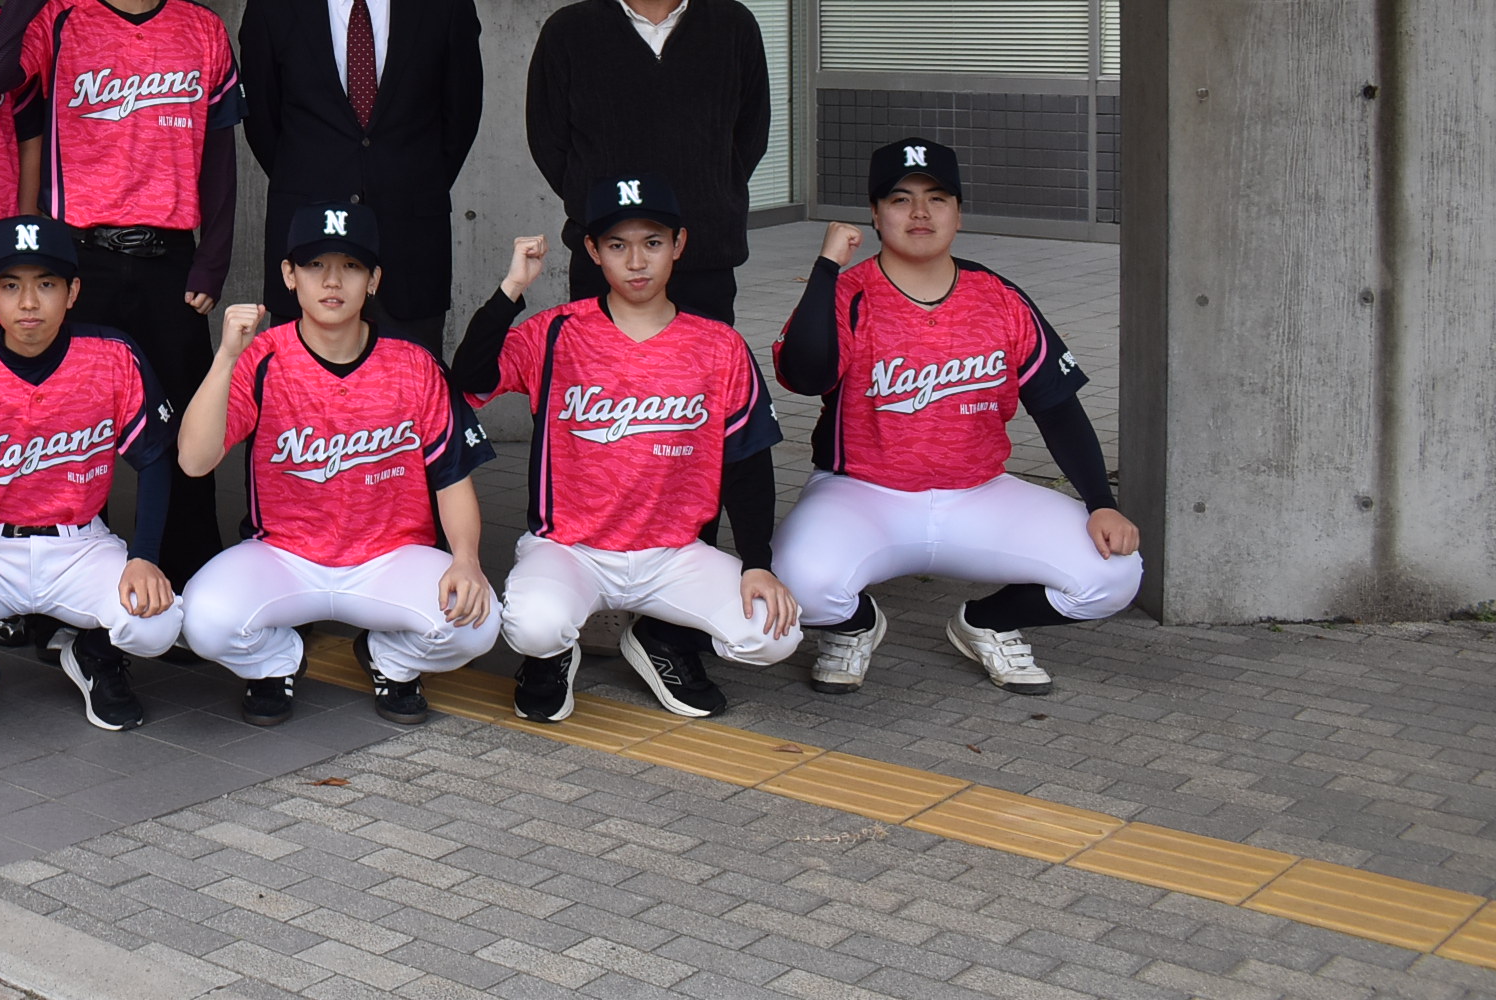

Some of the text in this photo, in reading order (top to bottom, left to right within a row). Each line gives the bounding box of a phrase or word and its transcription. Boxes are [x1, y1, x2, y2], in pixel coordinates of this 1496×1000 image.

[68, 68, 203, 121] Nagano
[903, 145, 927, 167] N
[616, 179, 643, 206] N
[323, 209, 349, 236] N
[15, 224, 40, 251] N
[865, 350, 1007, 415] Nagano
[558, 385, 708, 444] Nagano
[270, 420, 421, 483] Nagano
[653, 444, 670, 456] HLTH
[67, 471, 84, 484] HLTH
[95, 464, 108, 477] MED
[365, 473, 380, 485] HLTH
[391, 466, 405, 477] MED
